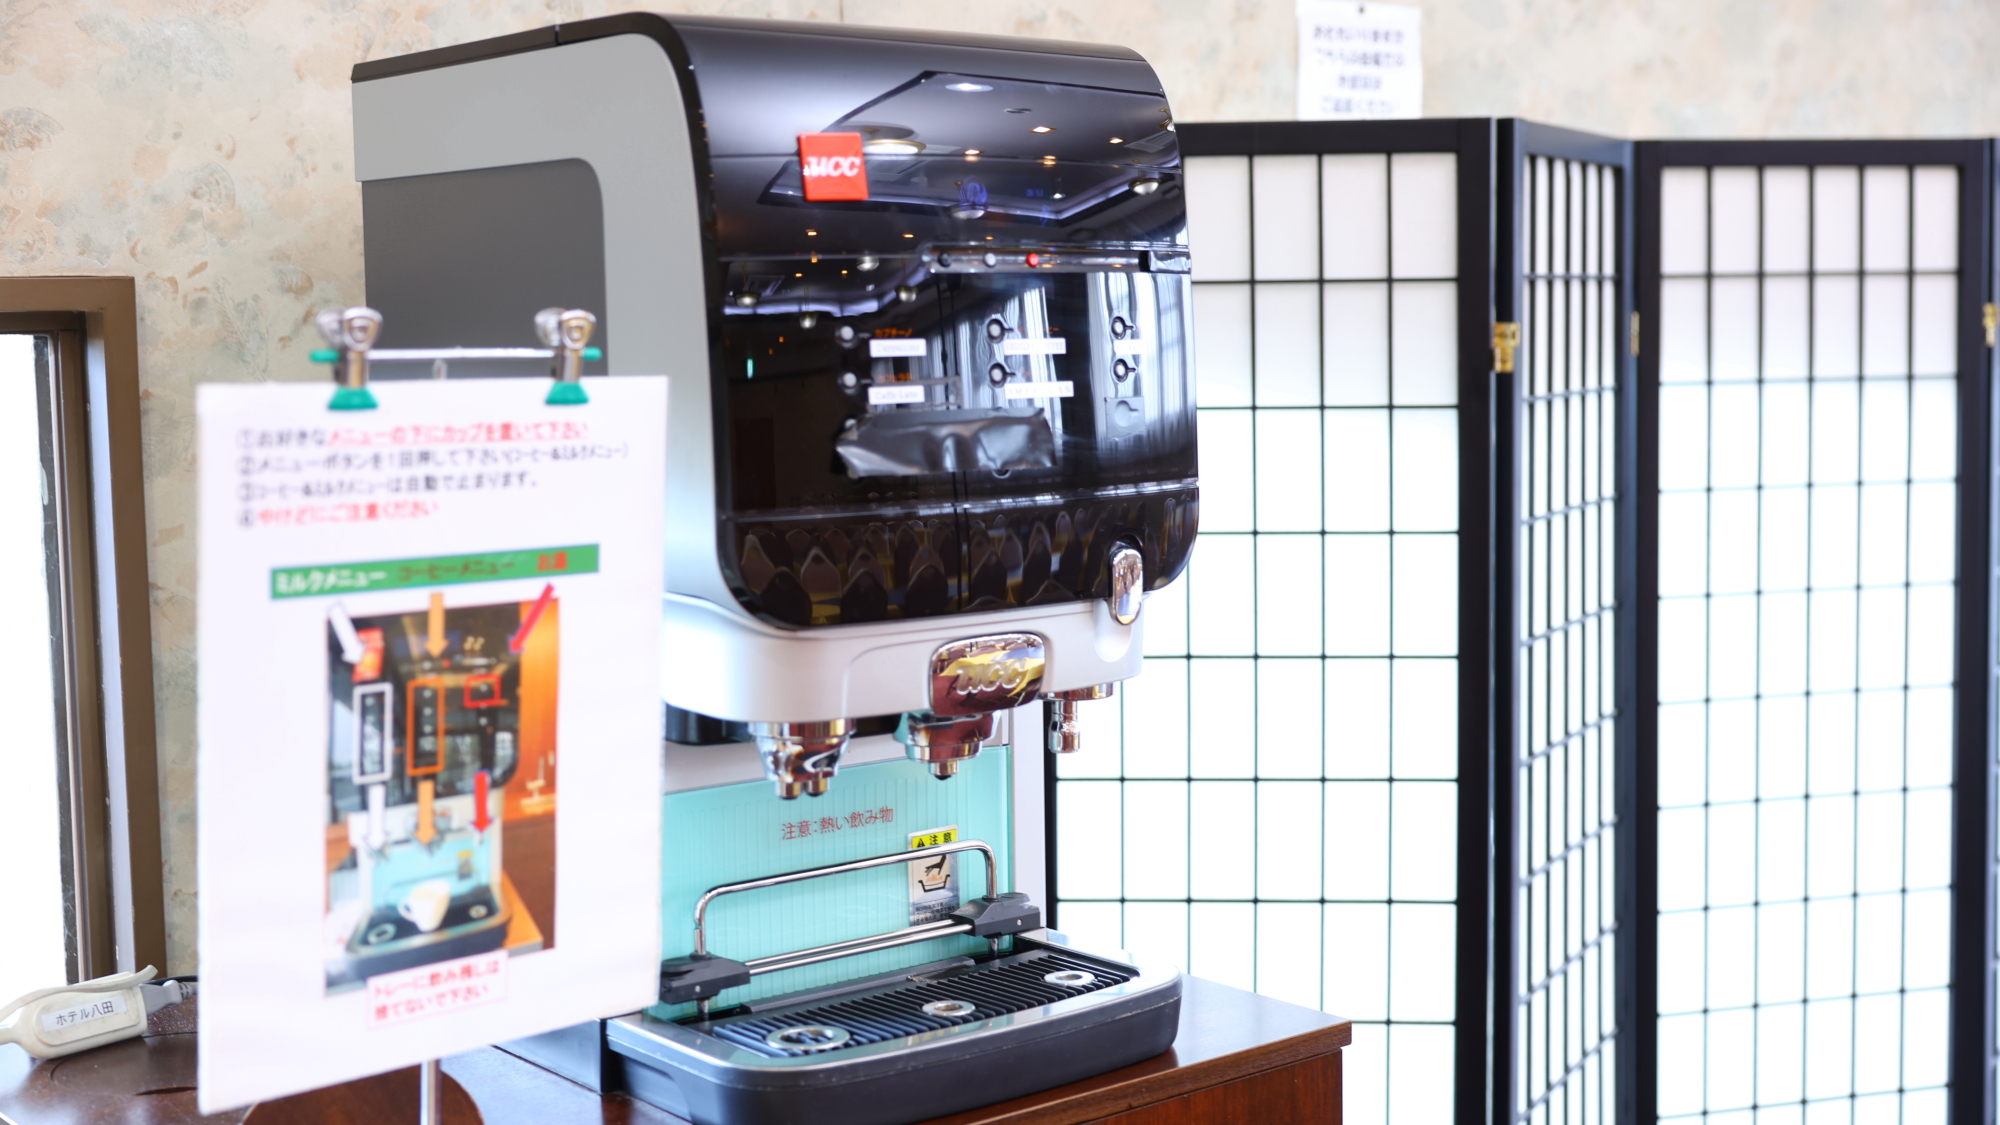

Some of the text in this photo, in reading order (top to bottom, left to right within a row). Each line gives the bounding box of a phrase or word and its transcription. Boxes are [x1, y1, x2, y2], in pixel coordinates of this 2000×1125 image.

[806, 155, 861, 177] UCC
[276, 568, 387, 594] ミルクメニュー
[398, 558, 515, 583] コーヒーメニュー
[956, 660, 1025, 695] UCC
[781, 806, 894, 840] 注意:熱い飲み物
[56, 1000, 114, 1026] ホテル八田
